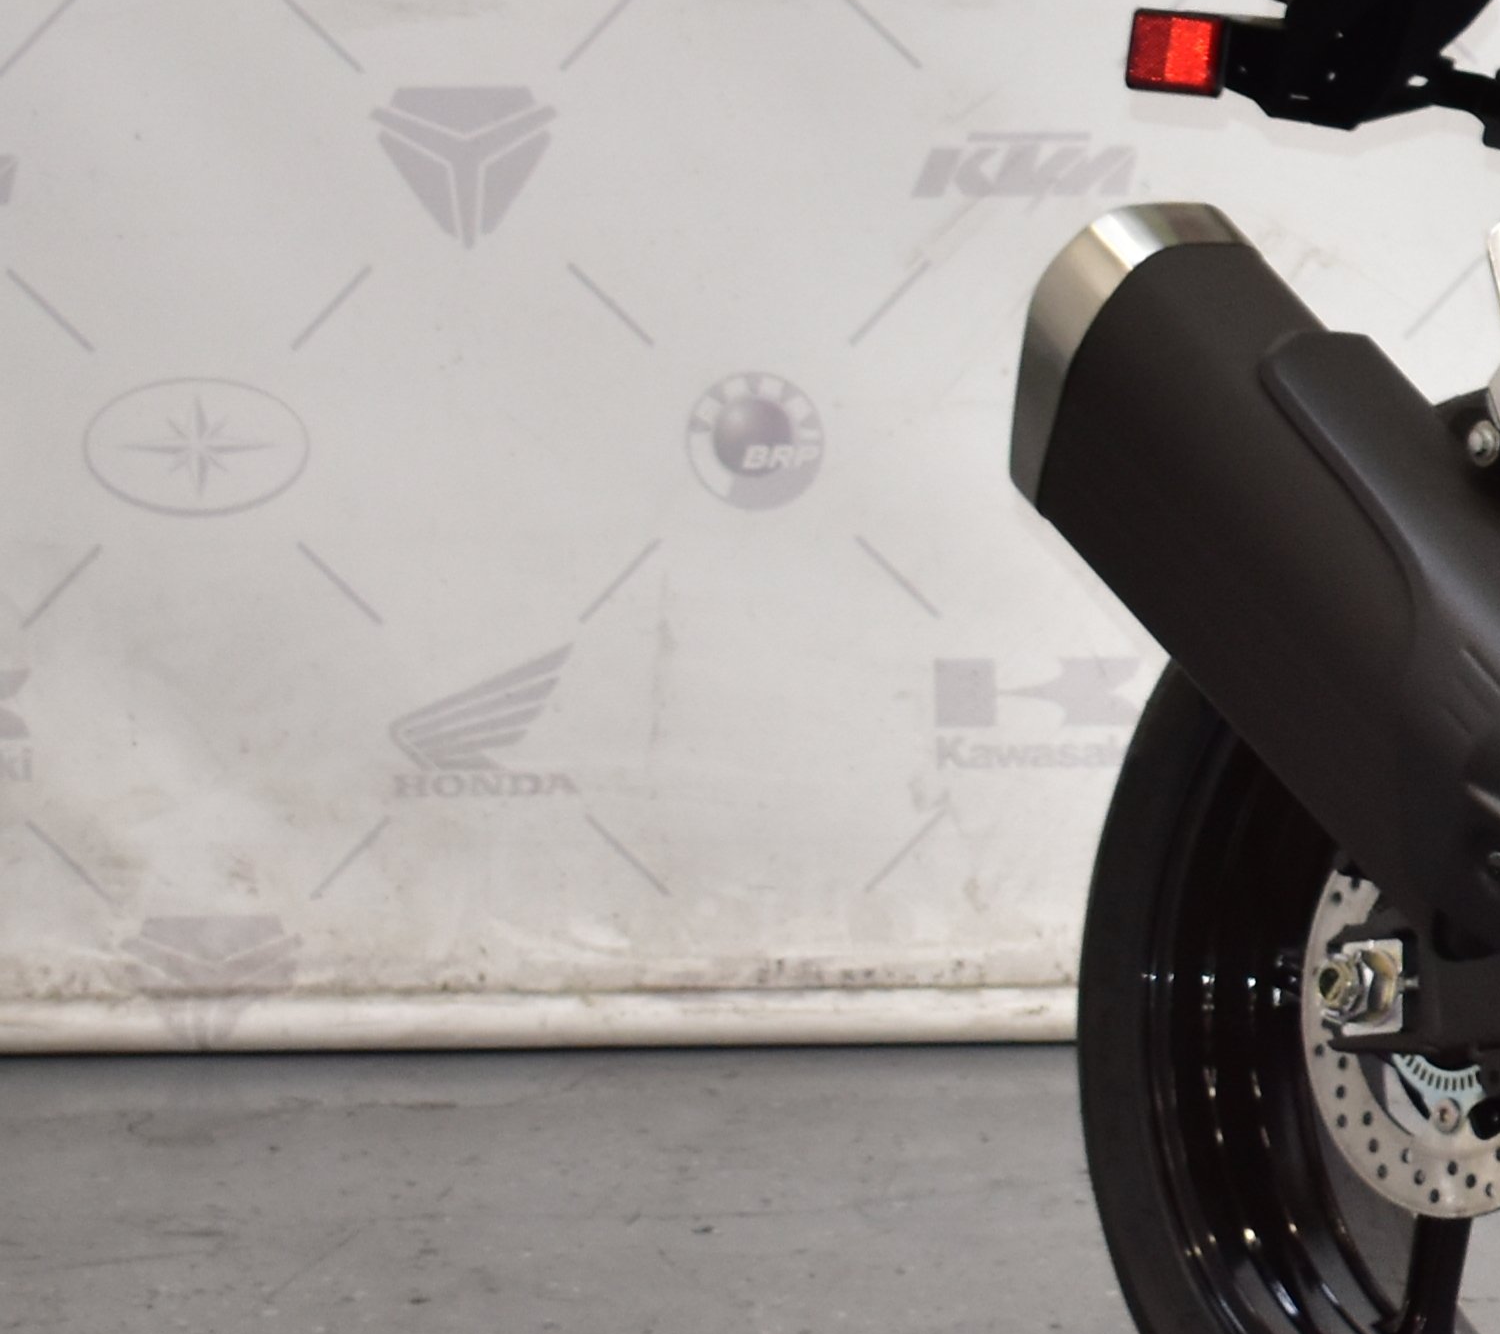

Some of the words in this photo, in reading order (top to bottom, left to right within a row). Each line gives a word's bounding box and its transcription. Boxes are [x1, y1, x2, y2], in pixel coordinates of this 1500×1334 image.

[911, 132, 1138, 199] KTM
[741, 445, 820, 470] BRP
[936, 735, 1123, 769] Kawasa
[392, 774, 578, 798] HONDA
